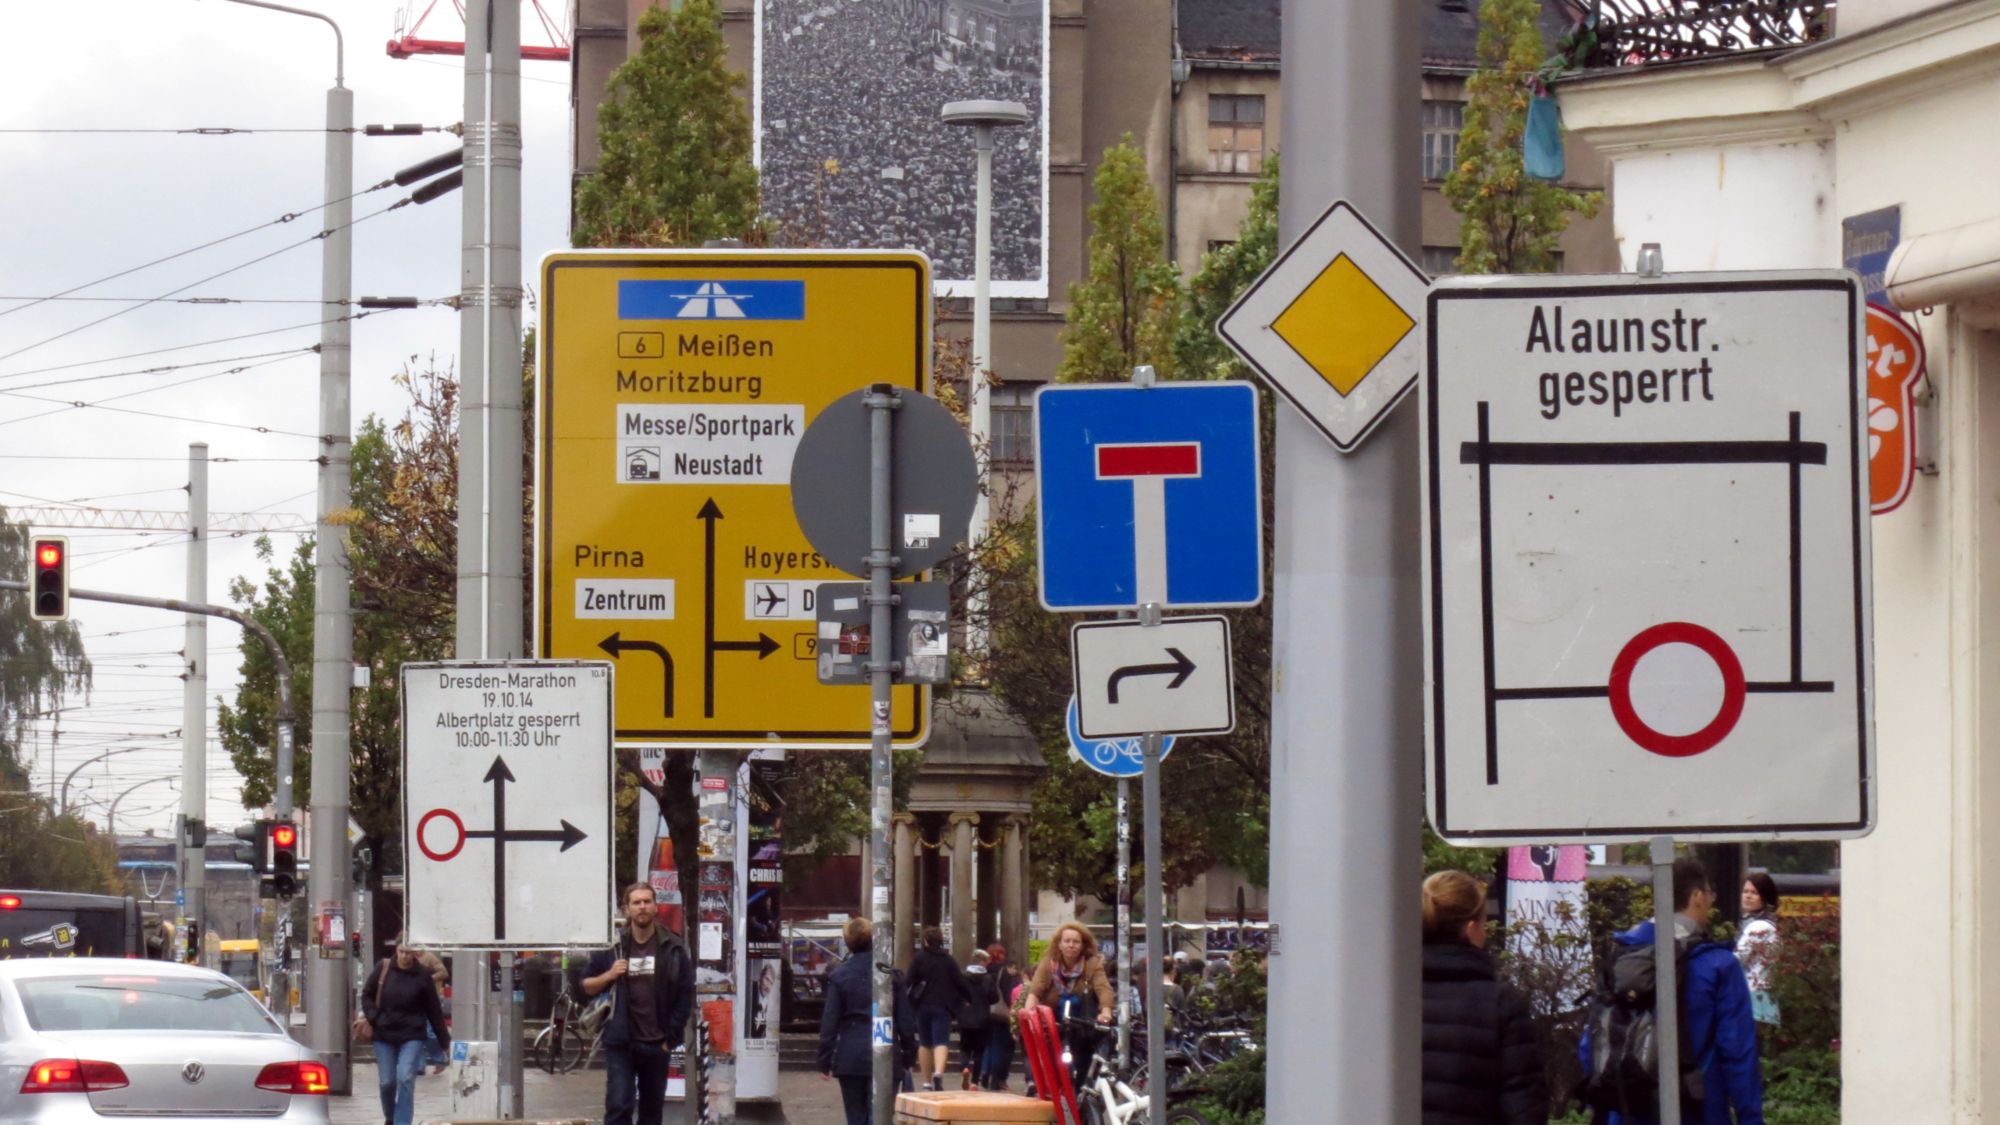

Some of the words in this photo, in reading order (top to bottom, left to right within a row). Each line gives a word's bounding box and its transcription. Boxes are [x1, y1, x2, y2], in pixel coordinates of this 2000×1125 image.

[1525, 305, 1720, 354] Alaunstr.
[635, 337, 646, 354] 6
[678, 334, 773, 357] Meißen
[617, 370, 762, 400] Moritzburg
[1538, 357, 1715, 420] gesperrt
[625, 413, 795, 442] Messe/Sportpark
[675, 453, 763, 476] Neustadt
[575, 544, 644, 568] Pirna
[744, 546, 835, 574] Hoyers
[584, 587, 666, 611] Zentrum
[439, 673, 577, 689] Dresden-Marathon
[482, 692, 533, 708] 19.10.14
[436, 713, 514, 732] Albertplatz
[518, 712, 580, 732] gesperrt
[455, 731, 530, 748] 10:00-11:30
[534, 730, 561, 747] Uhr
